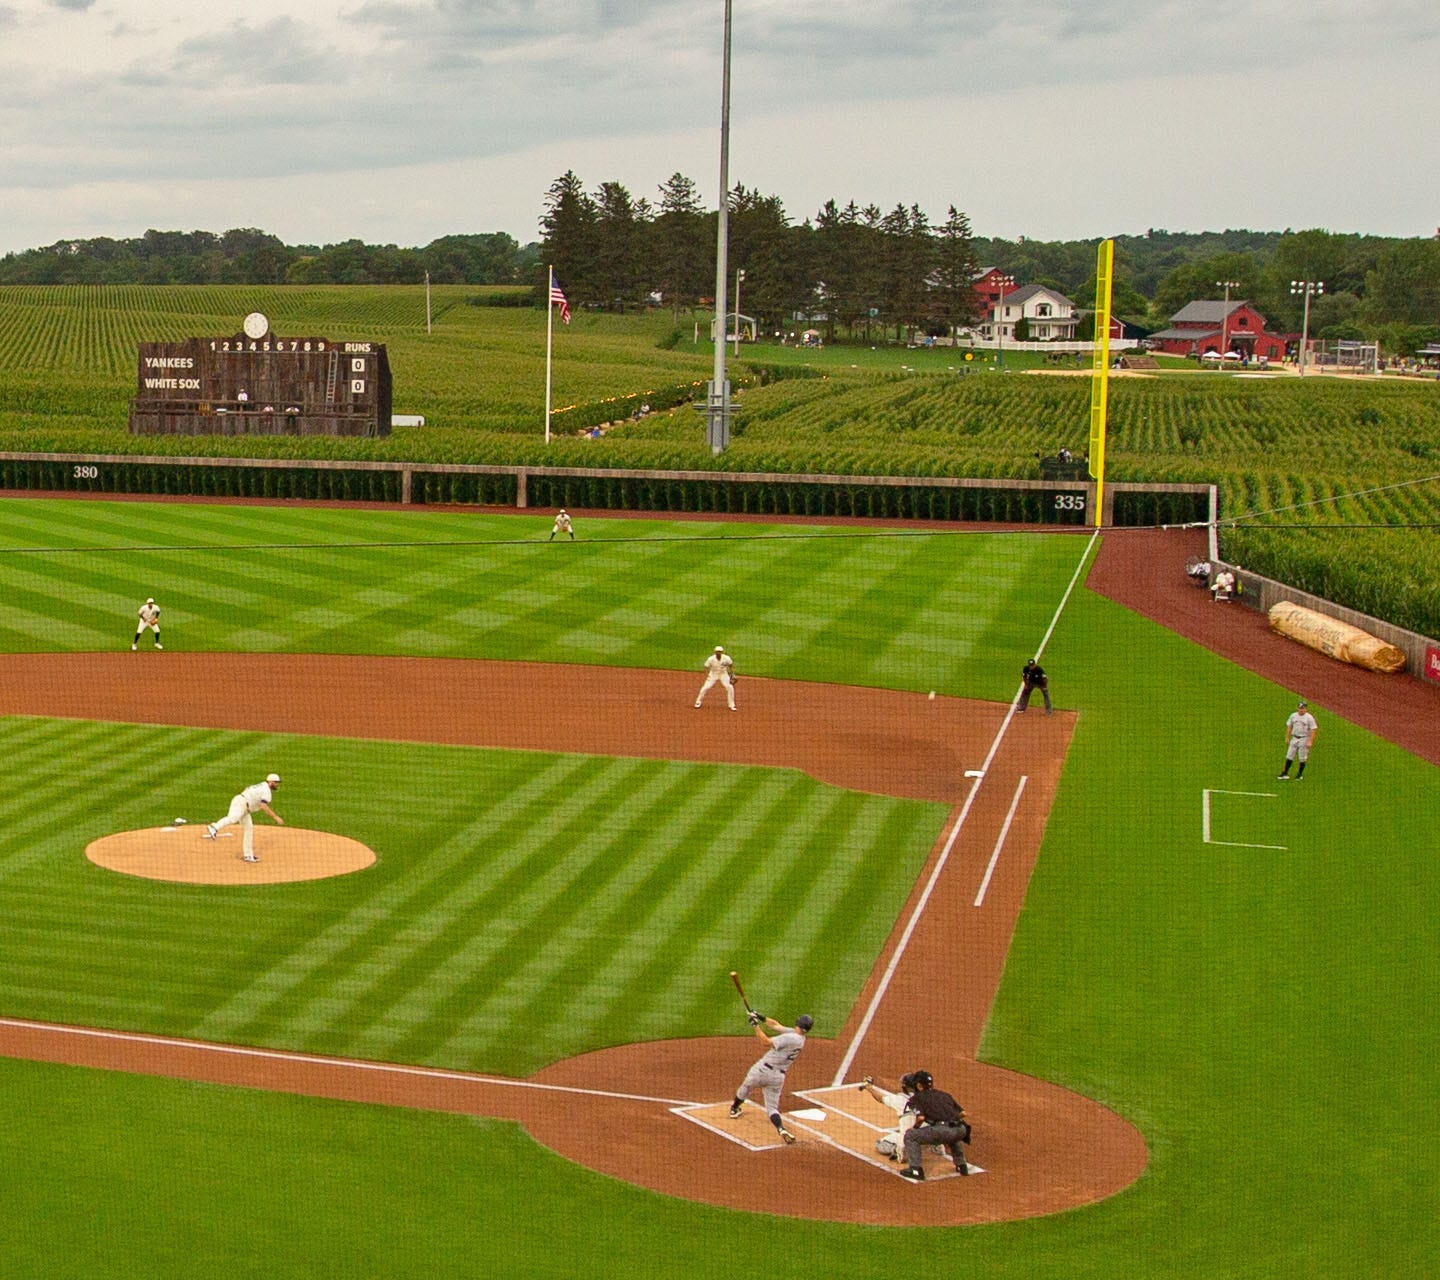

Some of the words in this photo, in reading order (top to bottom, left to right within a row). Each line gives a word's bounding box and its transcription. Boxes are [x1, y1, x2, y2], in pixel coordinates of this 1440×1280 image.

[210, 342, 216, 351] 1
[223, 342, 230, 351] 2
[236, 342, 243, 351] 3
[249, 342, 257, 351] 4
[263, 342, 270, 351] 5
[277, 342, 284, 351] 6
[290, 342, 298, 351] 7
[304, 342, 311, 351] 8
[318, 342, 325, 351] 9
[345, 343, 370, 352] RUNS
[145, 358, 193, 368] YANKEES
[355, 360, 362, 370] 0
[145, 379, 177, 389] WHITE
[178, 378, 200, 389] SOX
[355, 381, 362, 391] 0
[73, 465, 98, 479] 380
[1054, 495, 1085, 510] 335
